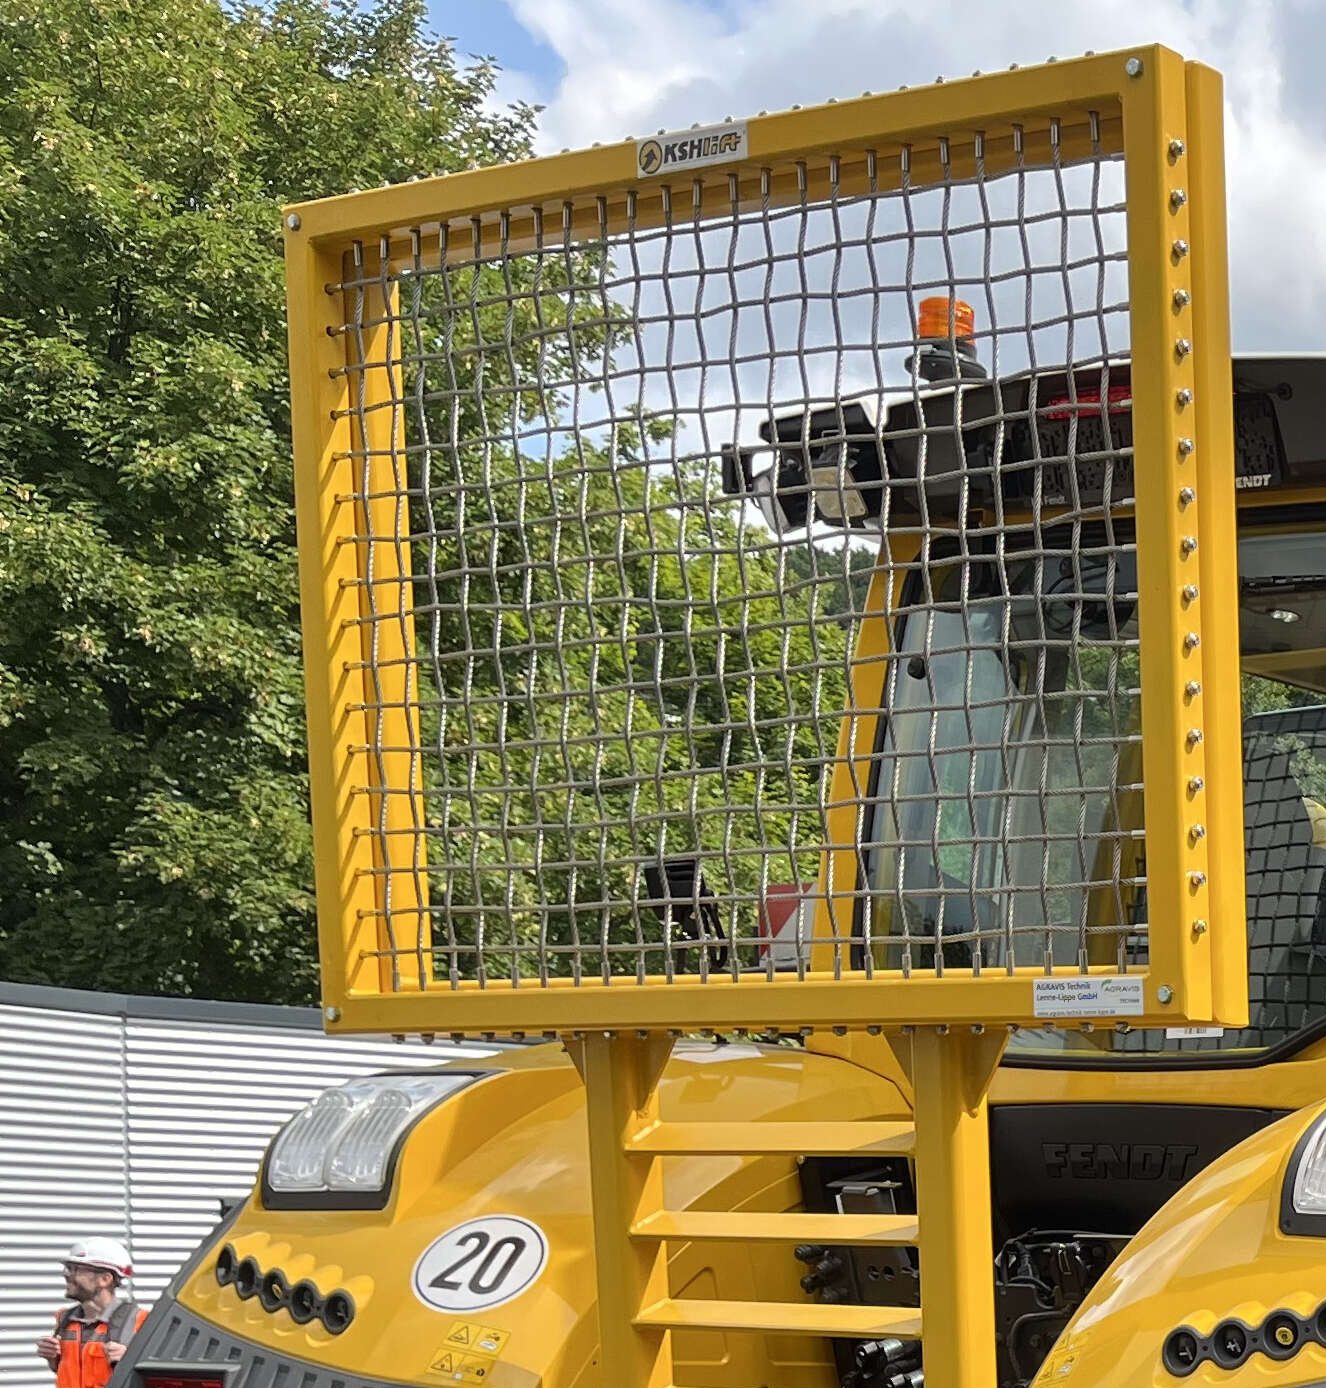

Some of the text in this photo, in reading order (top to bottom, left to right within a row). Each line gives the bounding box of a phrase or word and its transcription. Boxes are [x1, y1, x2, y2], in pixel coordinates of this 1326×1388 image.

[664, 131, 742, 164] KSHlift
[1236, 473, 1272, 488] ENDT
[1040, 1142, 1200, 1182] FENDT
[428, 1231, 527, 1295] 20
